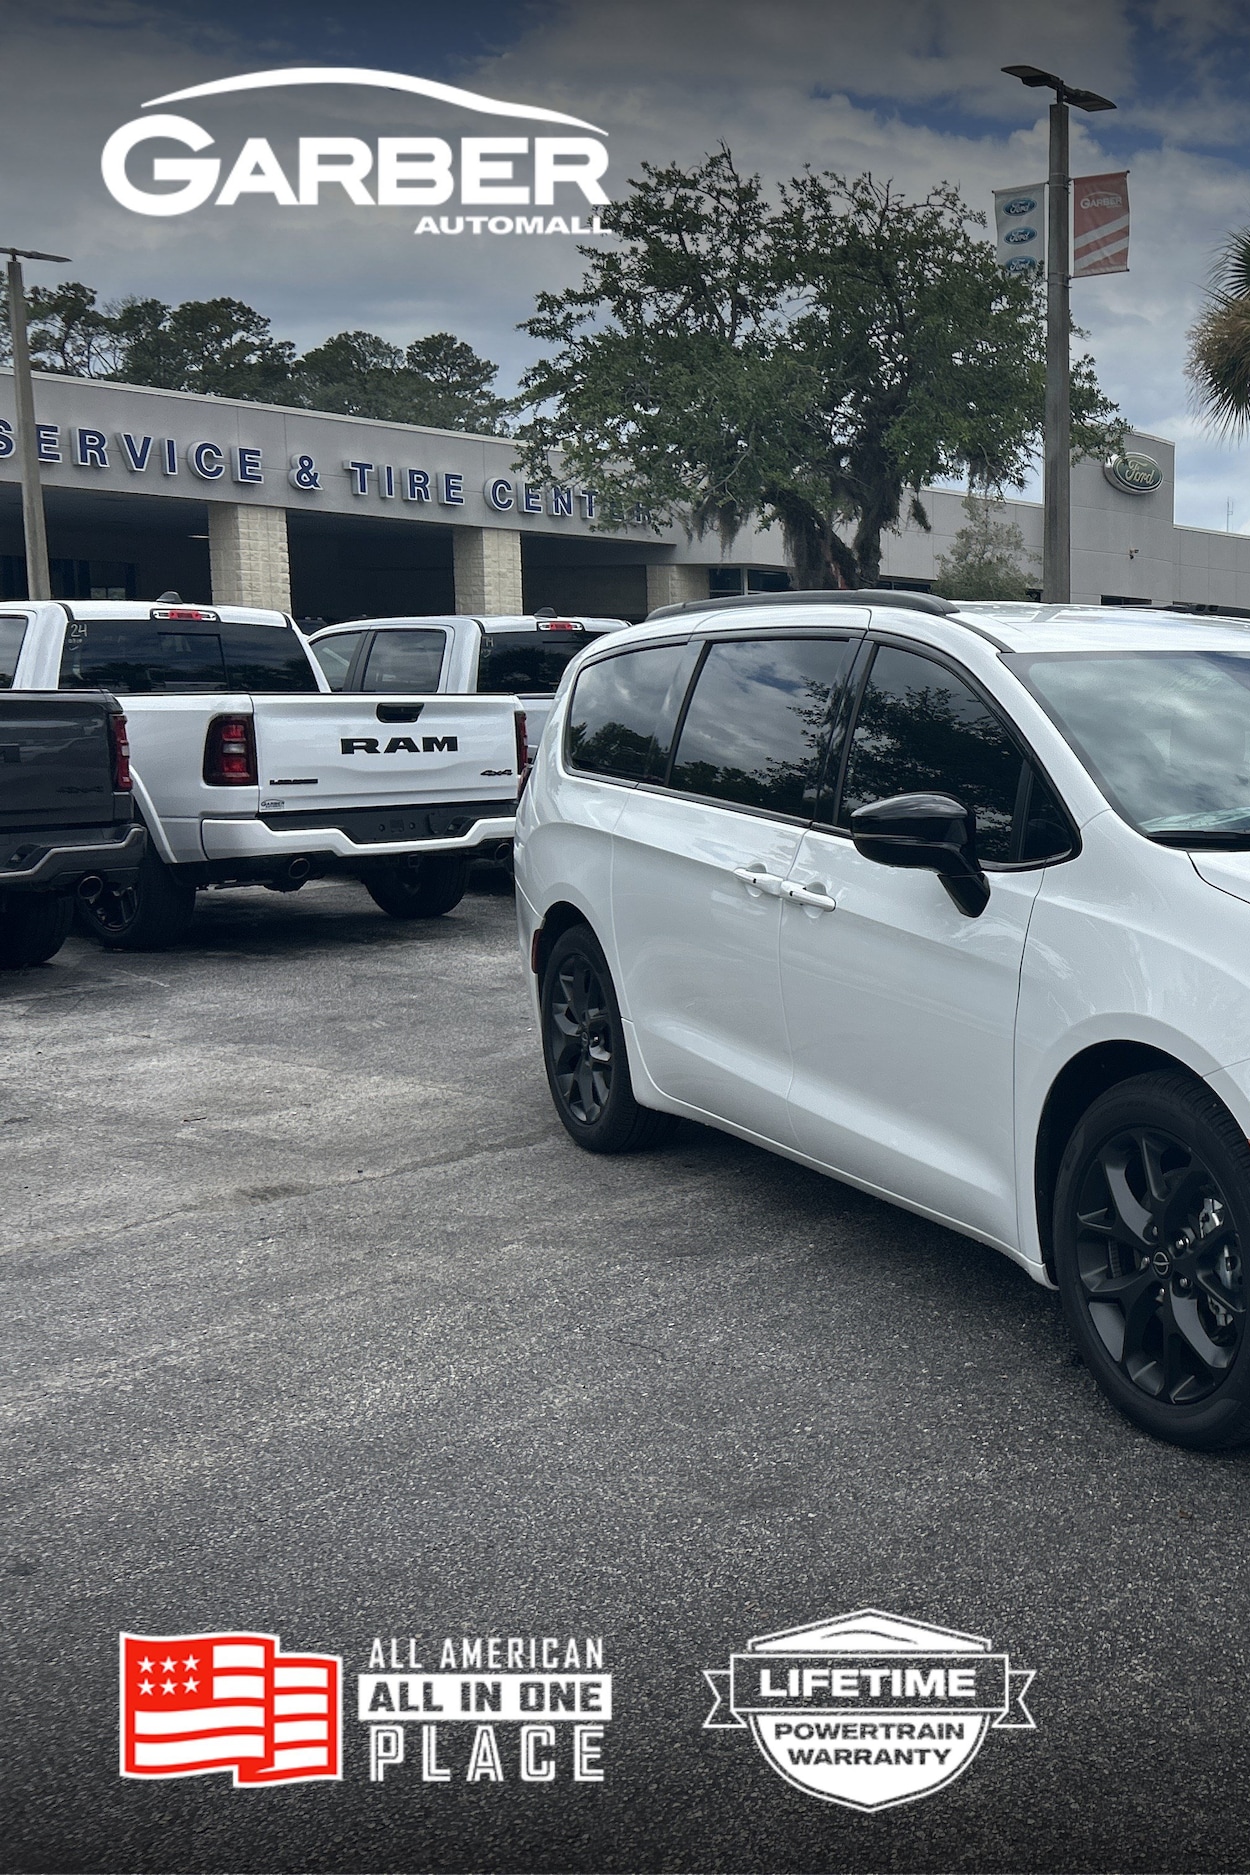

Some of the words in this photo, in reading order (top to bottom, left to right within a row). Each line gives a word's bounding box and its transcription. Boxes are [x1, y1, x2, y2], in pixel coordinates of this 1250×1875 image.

[1080, 196, 1122, 209] GARBER
[290, 453, 323, 491] &
[346, 460, 466, 506] TIRE
[1124, 459, 1156, 485] Ford
[70, 623, 88, 637] 24
[340, 736, 459, 755] RAM
